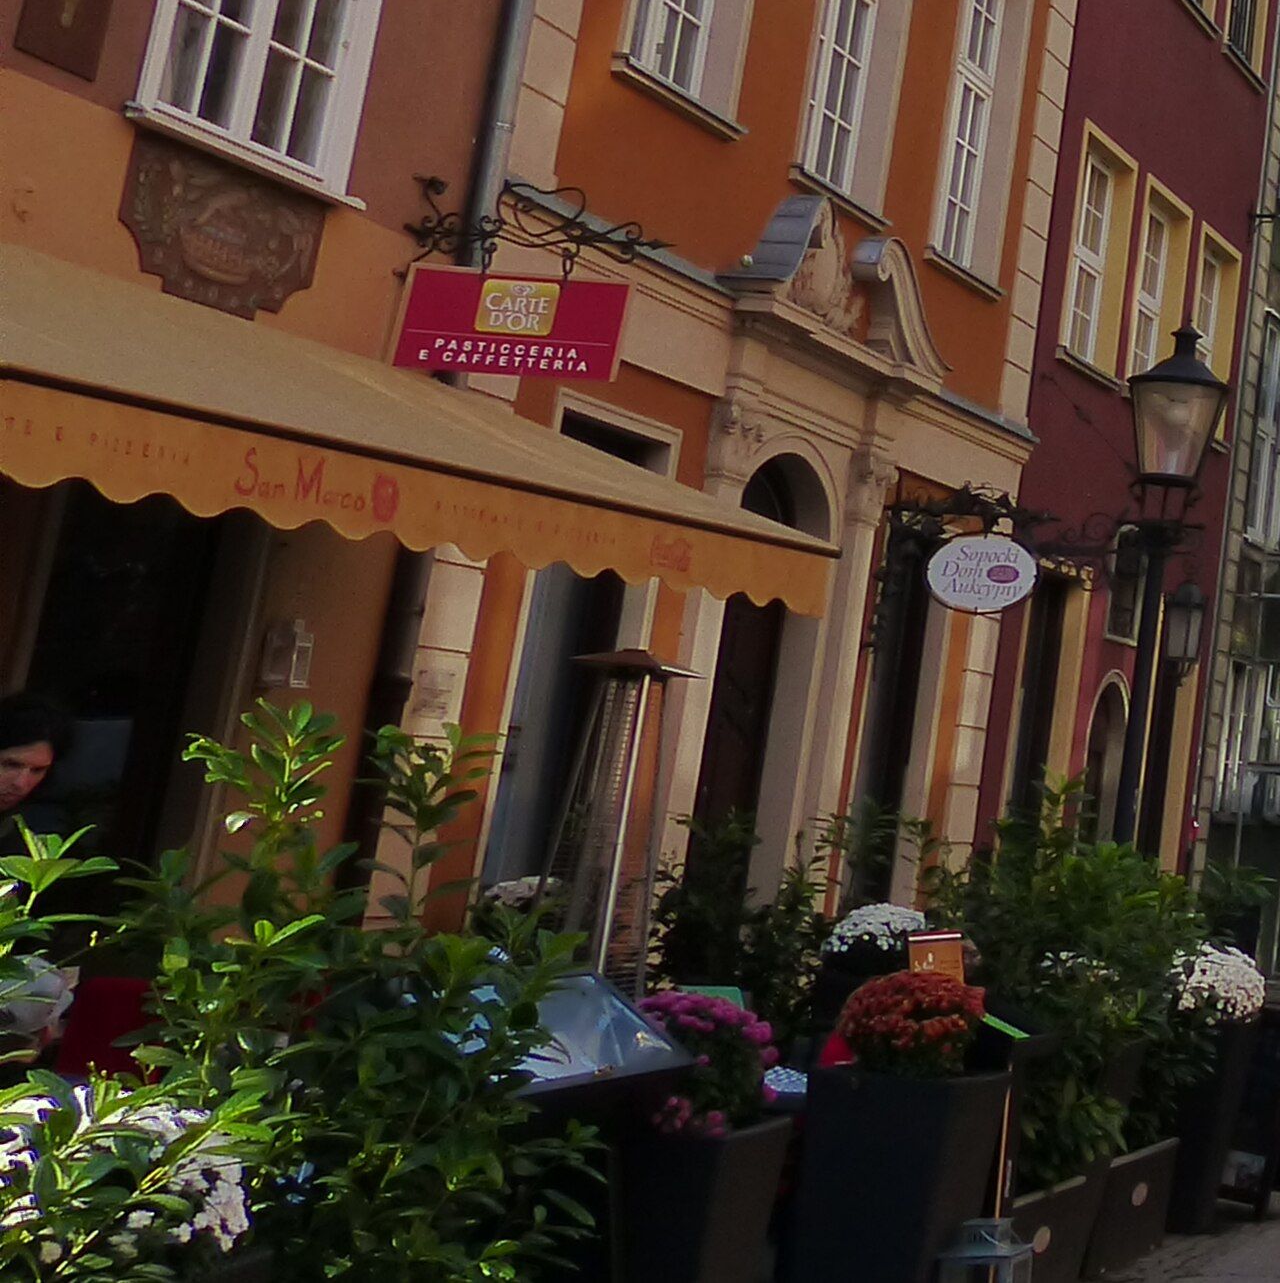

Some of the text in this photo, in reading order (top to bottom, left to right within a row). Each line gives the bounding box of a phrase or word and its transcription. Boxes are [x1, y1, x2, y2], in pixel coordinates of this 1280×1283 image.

[485, 292, 551, 315] CARTE
[434, 338, 578, 359] PASTICCERIA
[418, 349, 588, 373] E CAFFETTERIA
[234, 447, 366, 512] San Marco
[956, 544, 1020, 564] Sopocki
[941, 560, 984, 578] Dom
